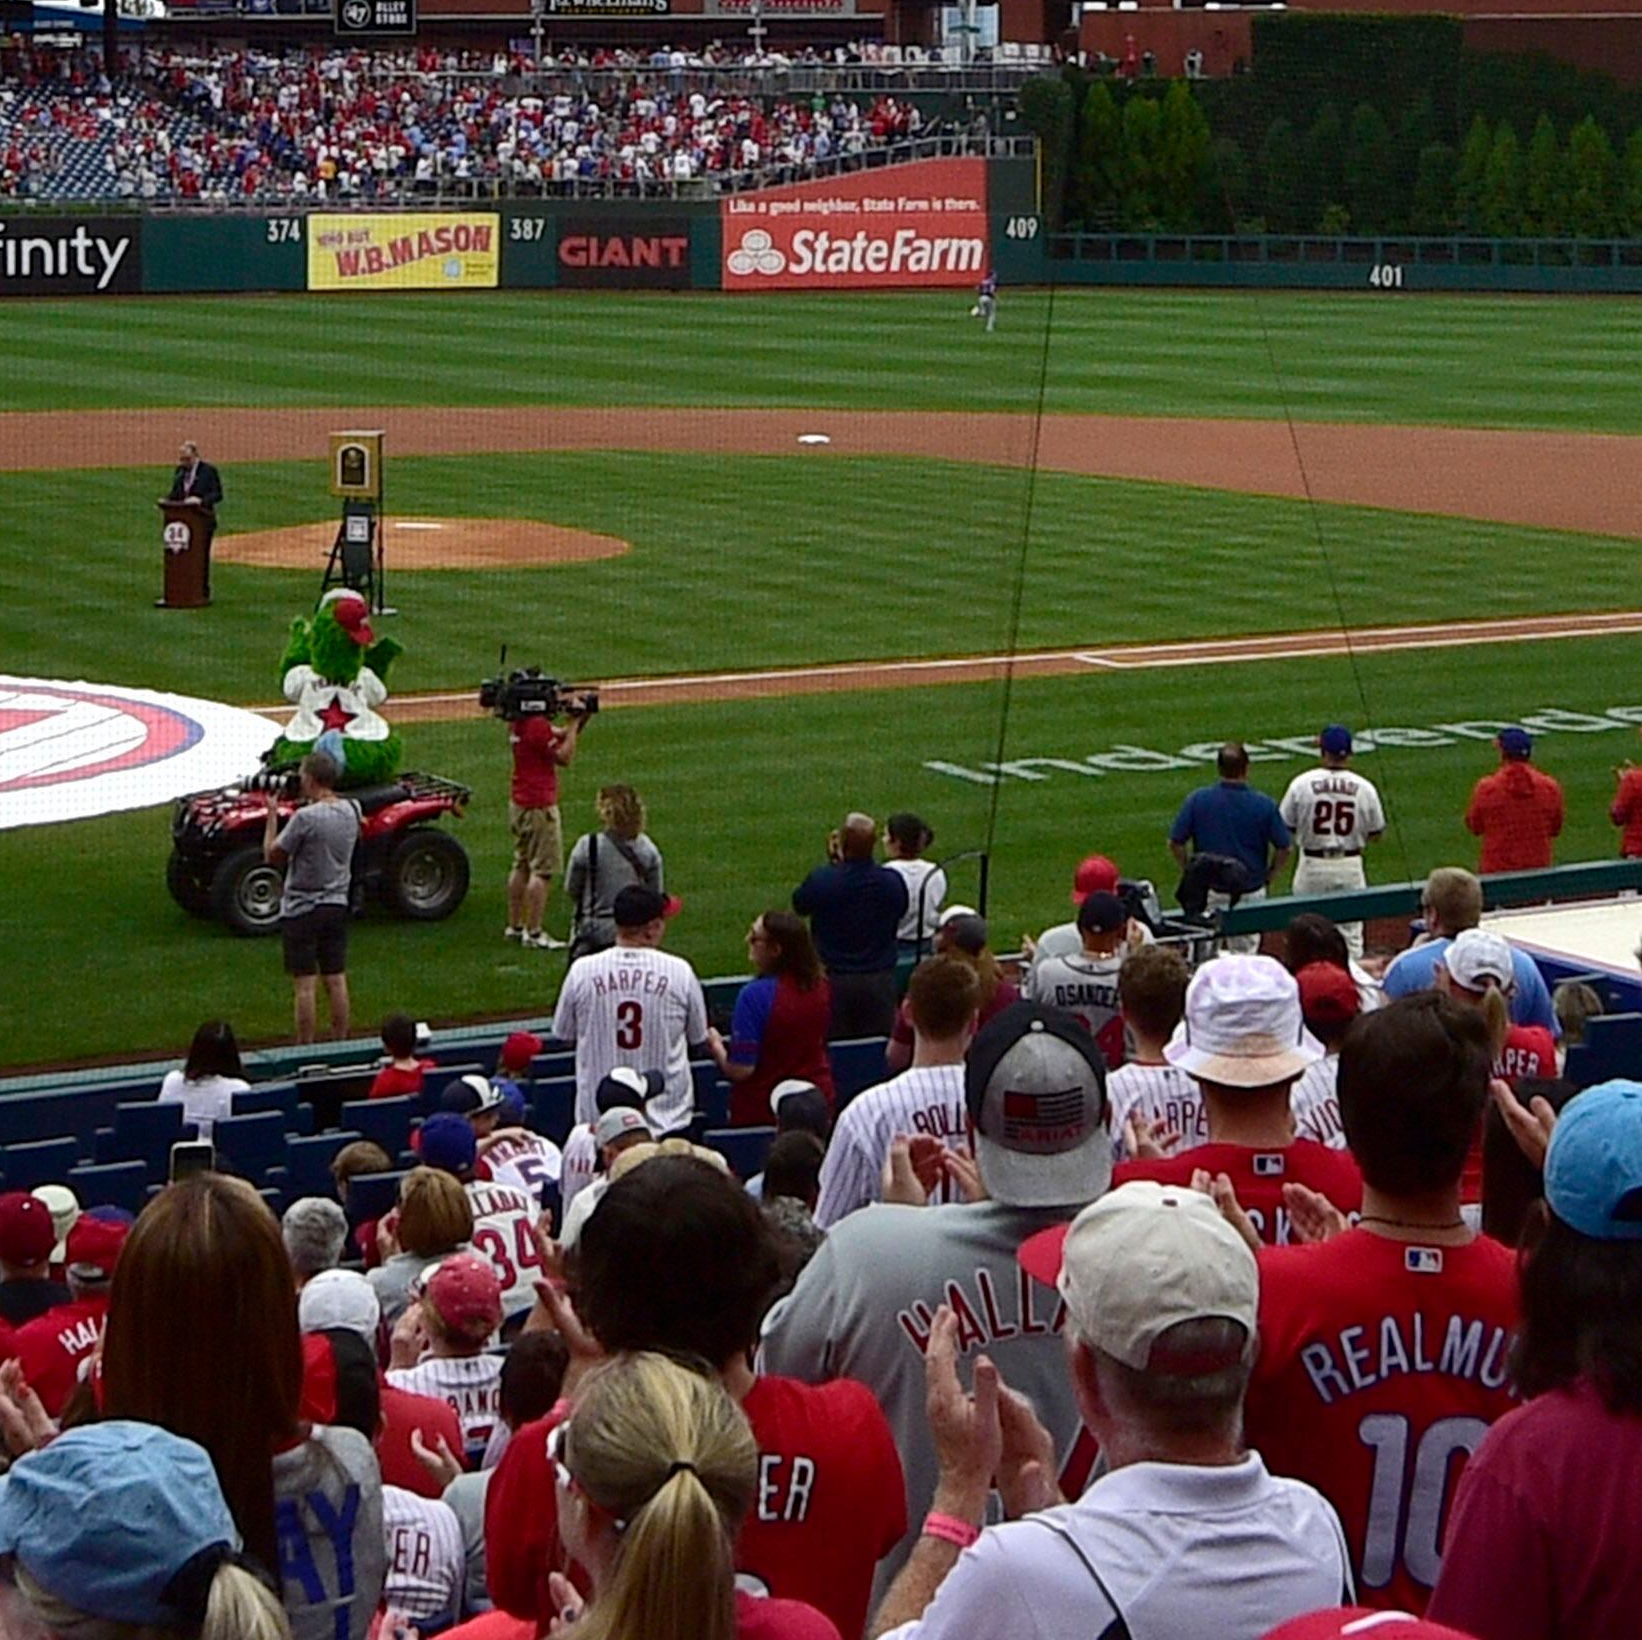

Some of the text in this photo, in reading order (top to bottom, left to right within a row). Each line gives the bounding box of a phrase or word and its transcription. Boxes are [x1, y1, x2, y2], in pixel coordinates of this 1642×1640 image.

[862, 198, 895, 212] State
[897, 197, 930, 212] Farm
[267, 219, 301, 242] 374
[510, 219, 545, 241] 387
[1006, 216, 1038, 239] 409
[558, 237, 688, 268] GIANT
[1369, 263, 1403, 288] 401
[592, 969, 670, 1000] HARPER
[616, 999, 644, 1050] 3
[897, 1270, 1069, 1360] HALL
[1300, 1312, 1525, 1404] REALMU
